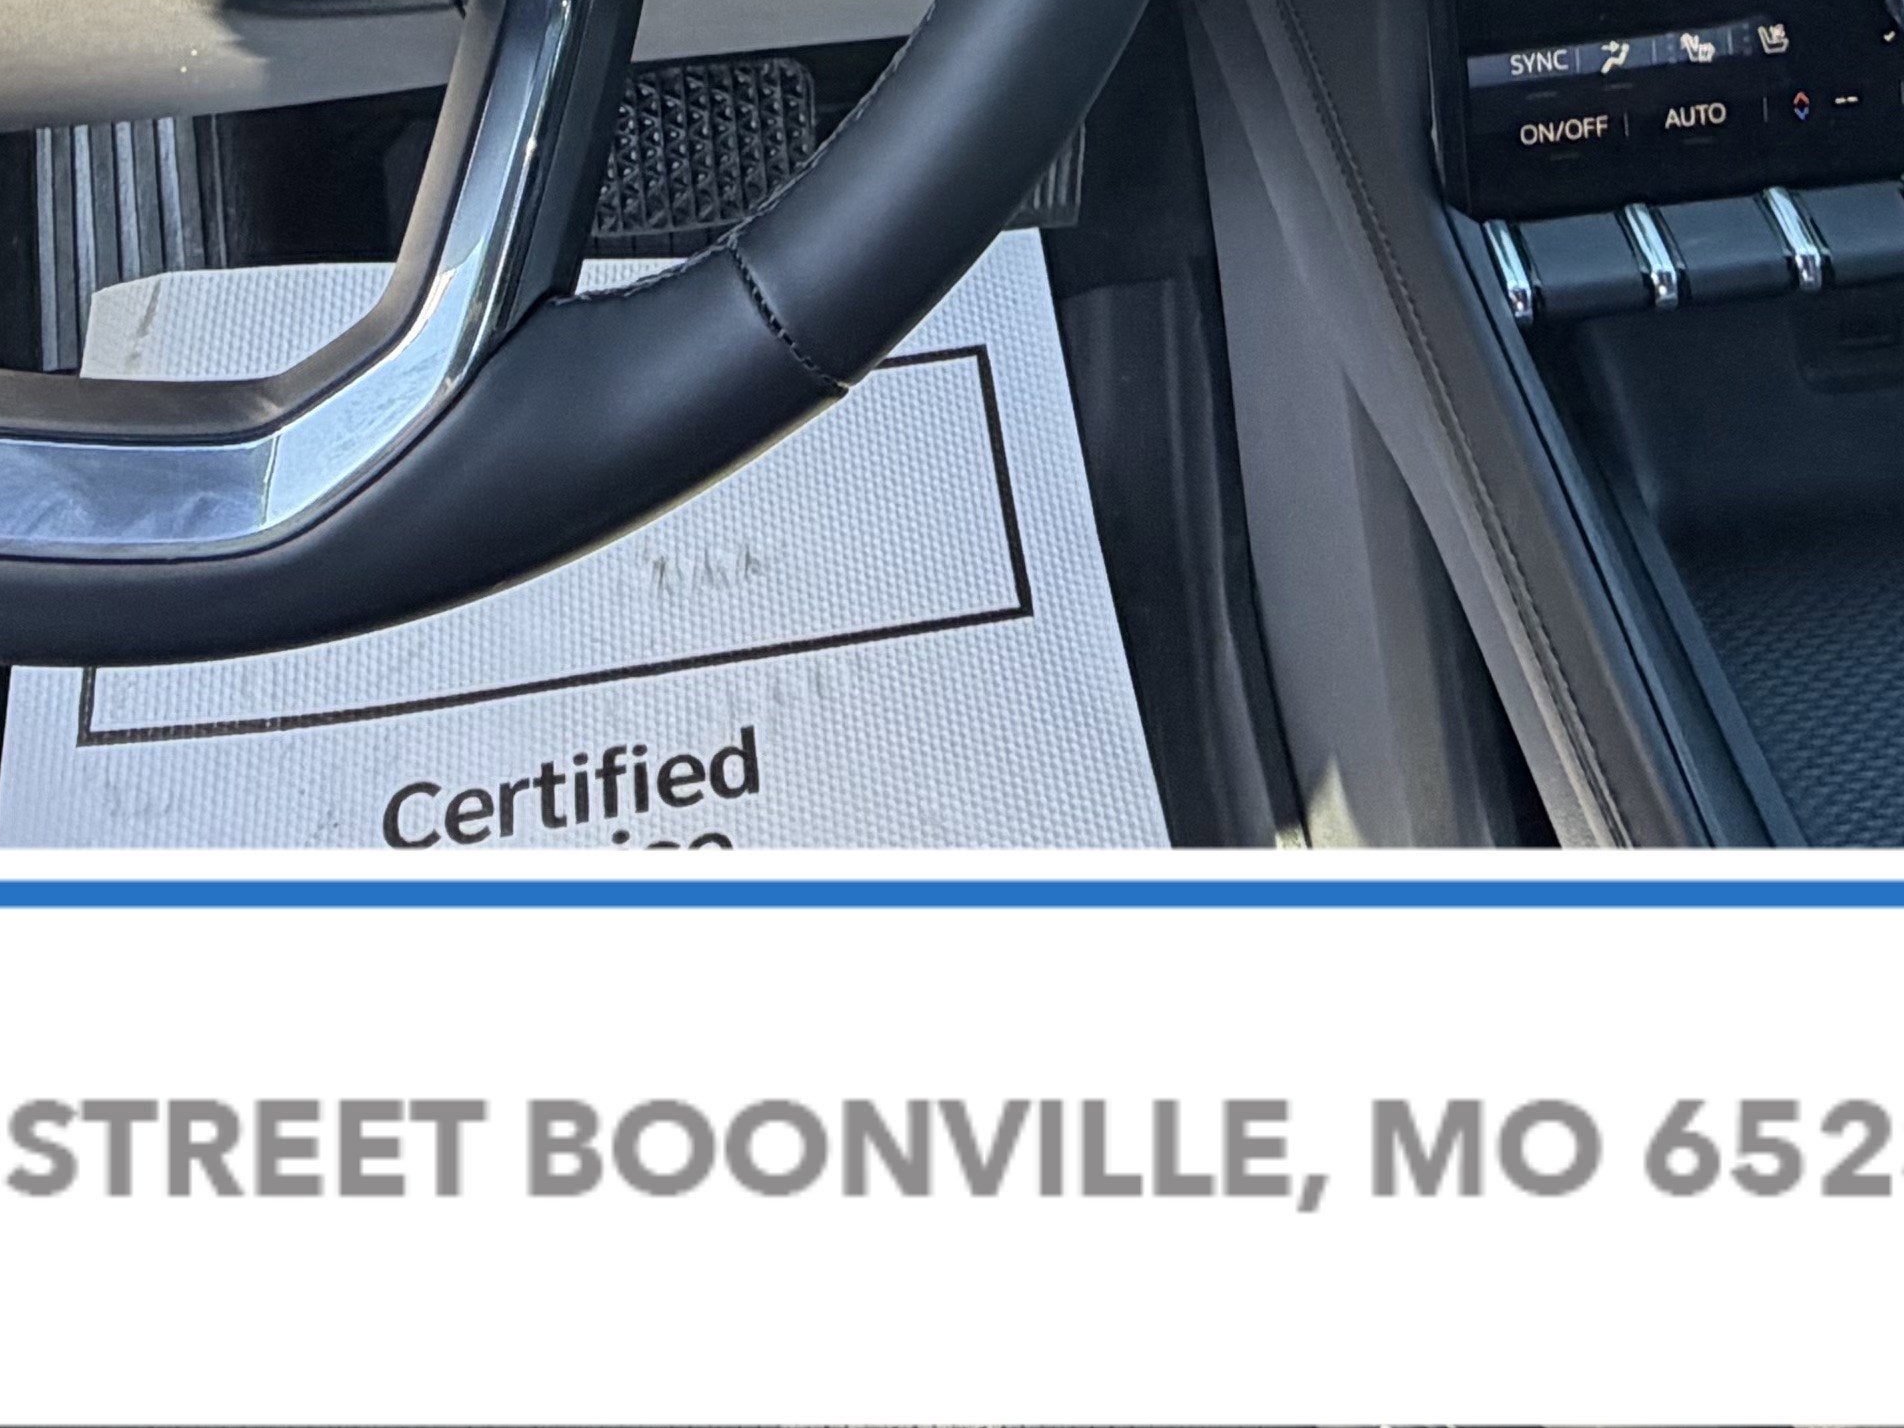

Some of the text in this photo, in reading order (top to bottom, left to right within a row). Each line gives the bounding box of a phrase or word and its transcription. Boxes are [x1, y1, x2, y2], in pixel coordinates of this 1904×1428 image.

[1510, 49, 1569, 76] SYNC
[1520, 115, 1608, 145] ON/OFF
[1665, 103, 1727, 129] AUTO
[382, 725, 760, 850] Certified
